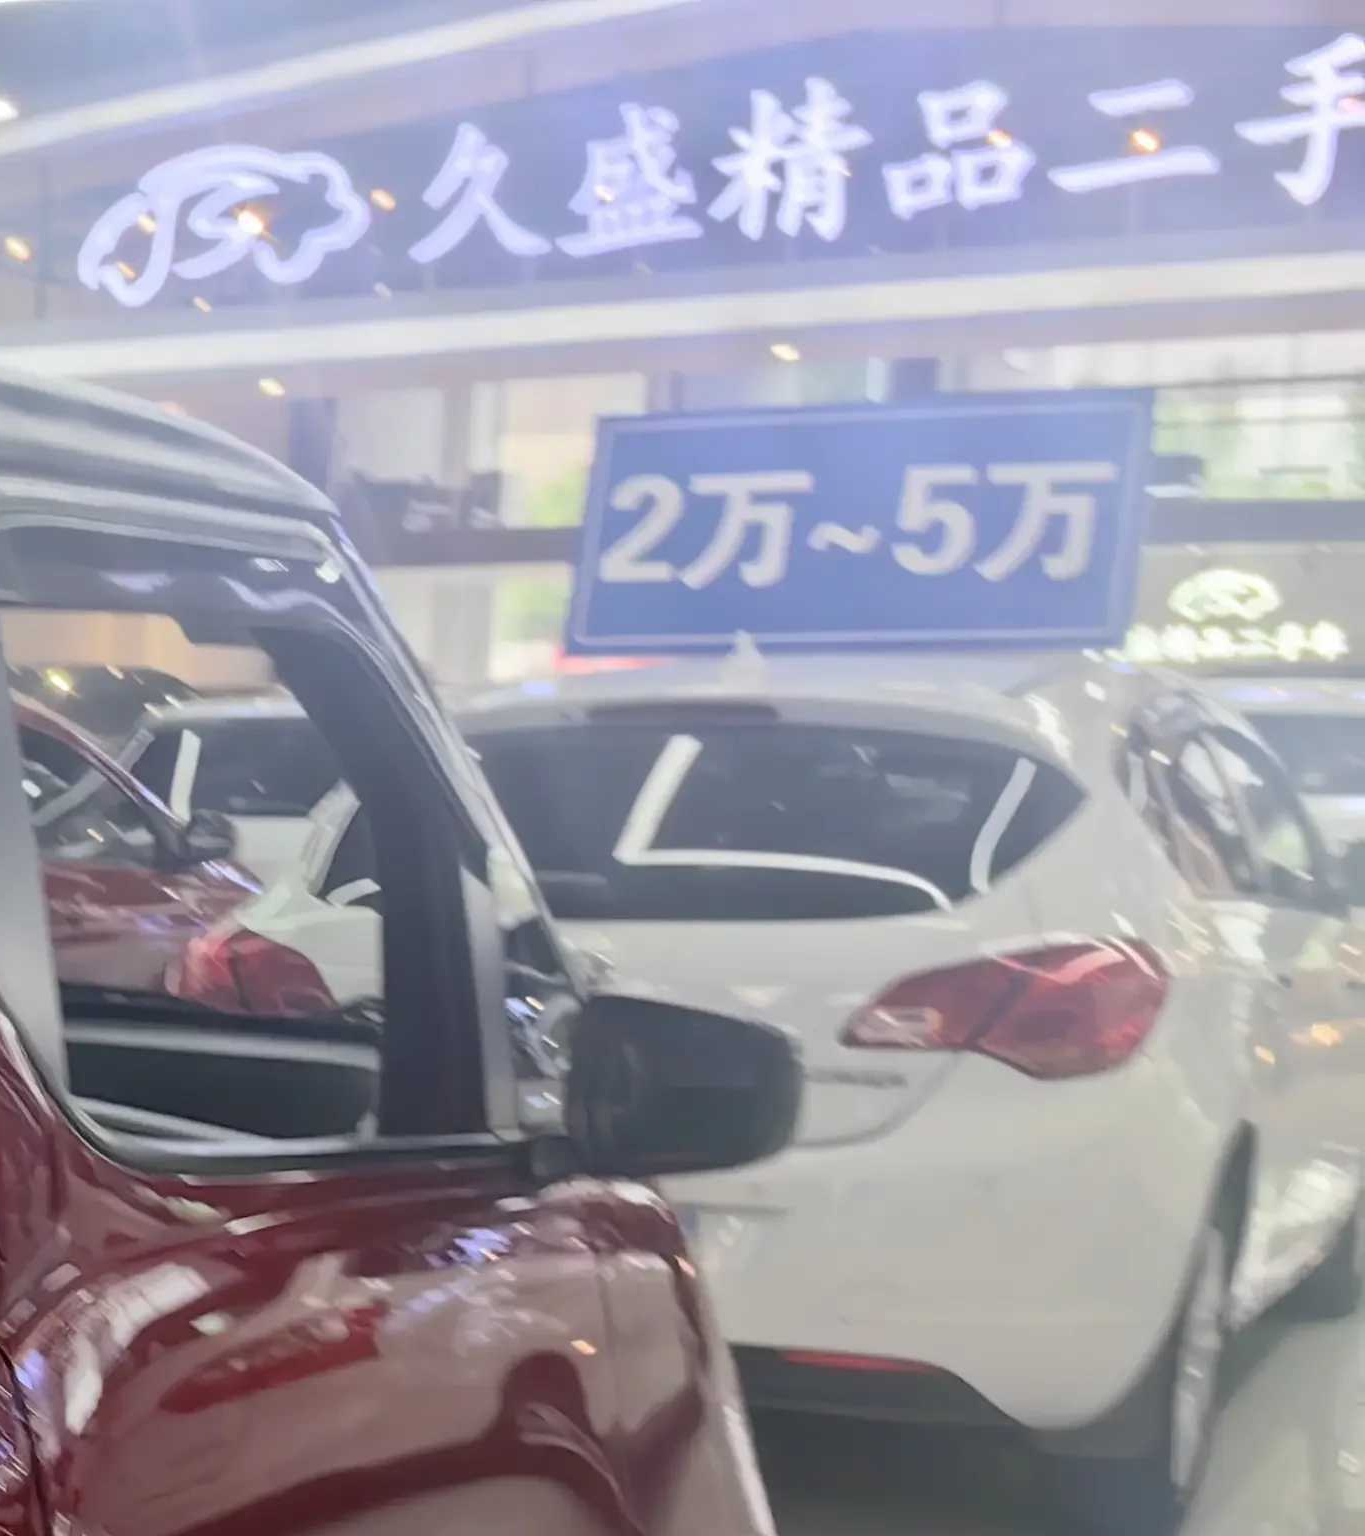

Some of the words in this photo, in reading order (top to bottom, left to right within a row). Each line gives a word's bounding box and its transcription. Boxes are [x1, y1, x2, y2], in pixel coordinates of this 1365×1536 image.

[407, 33, 1365, 263] 久盛精品二手
[599, 461, 1120, 590] 2万~5万
